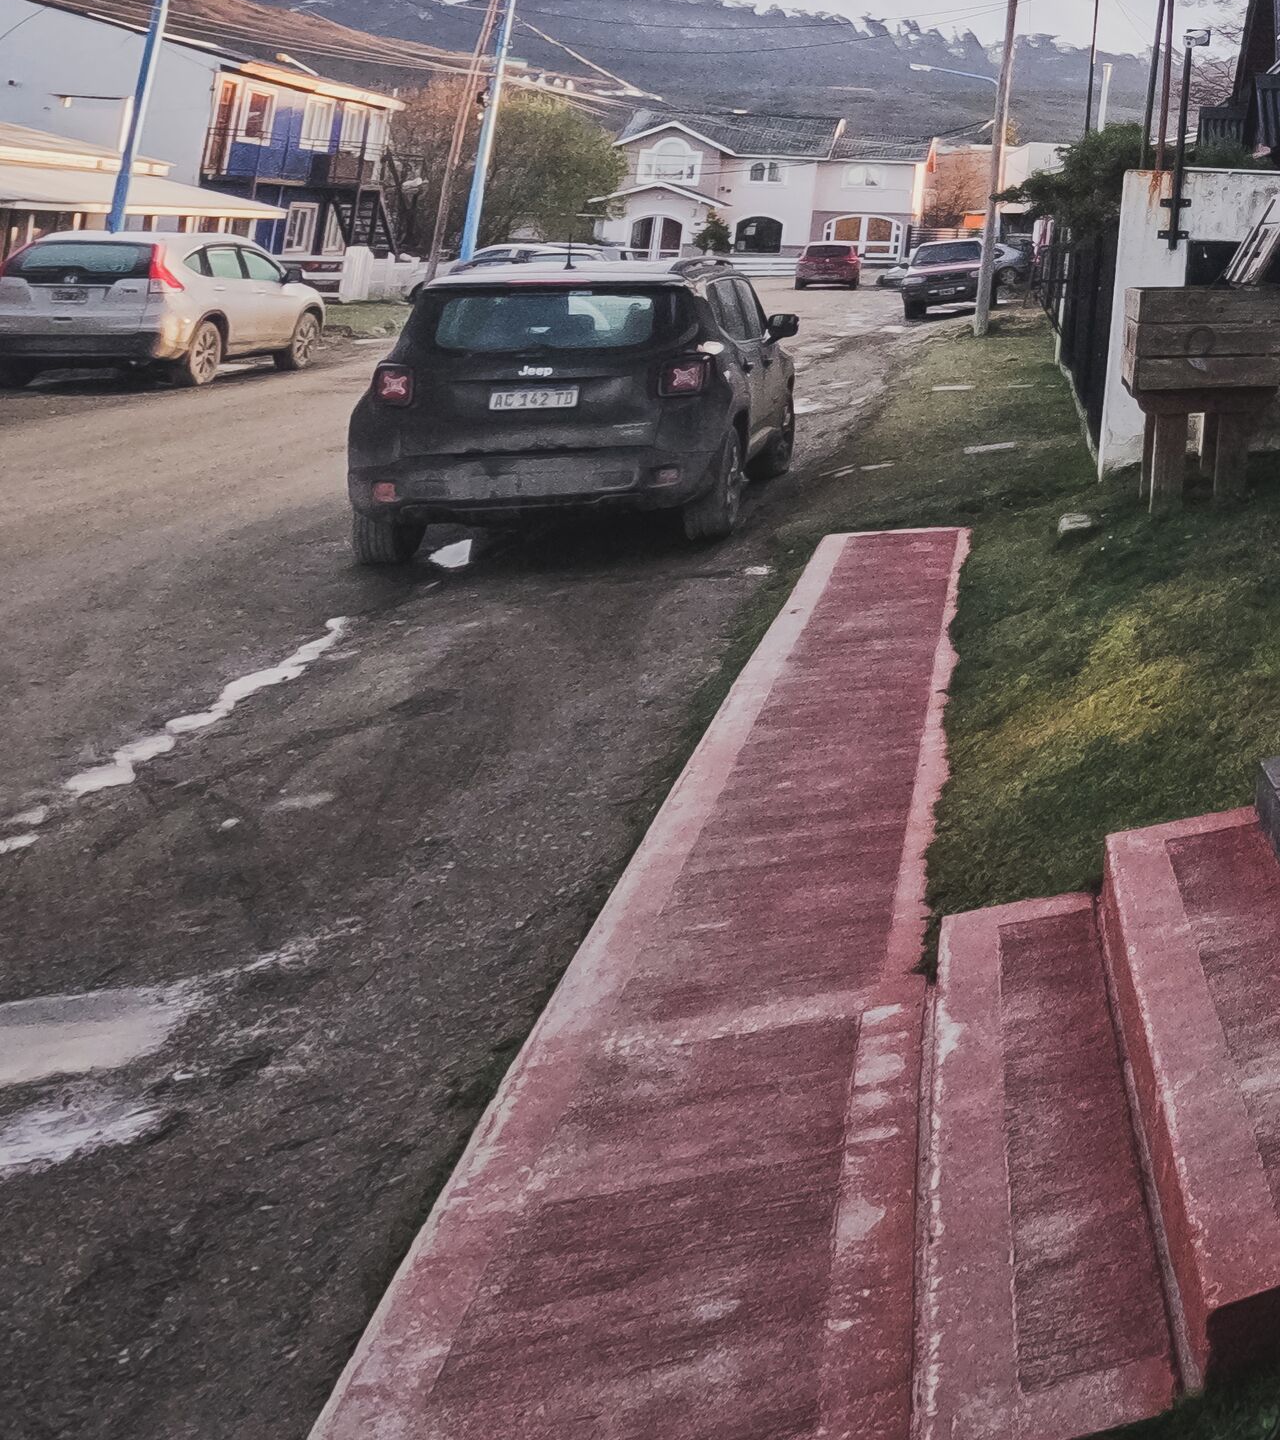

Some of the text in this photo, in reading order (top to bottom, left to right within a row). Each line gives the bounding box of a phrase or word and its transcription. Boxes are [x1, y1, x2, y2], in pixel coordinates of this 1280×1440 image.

[518, 365, 553, 376] Jeep
[494, 394, 514, 408] AC
[517, 392, 549, 407] 142
